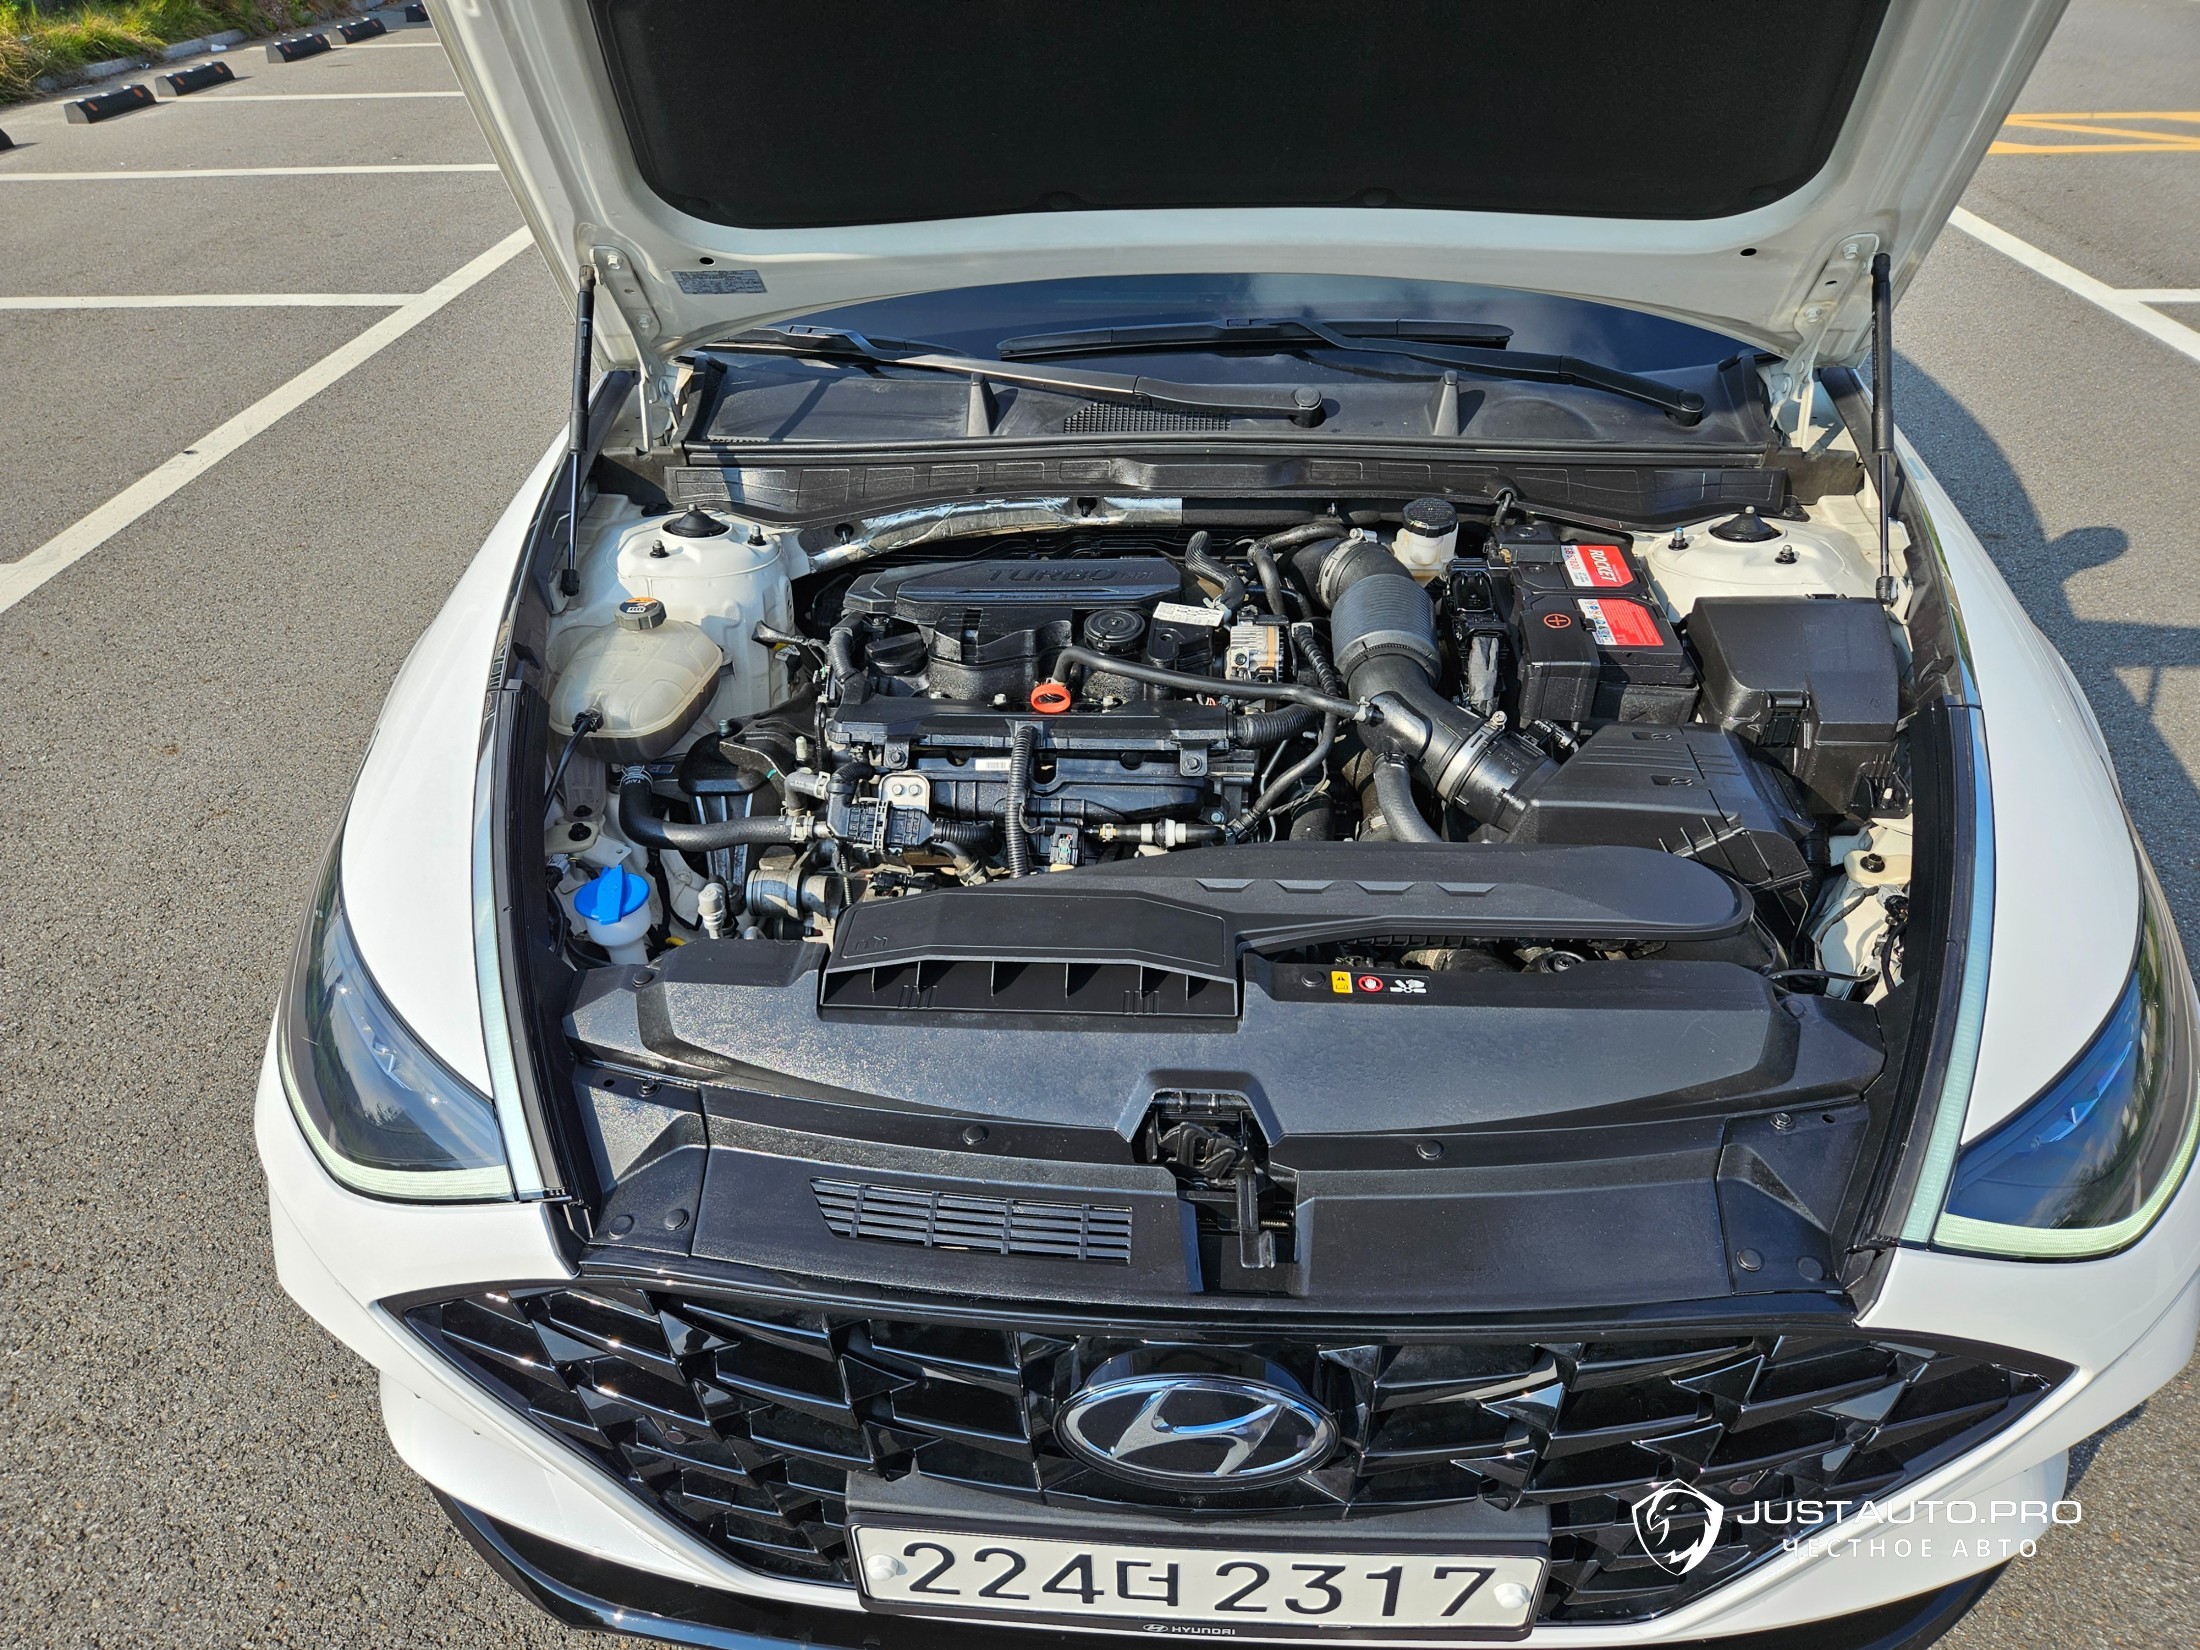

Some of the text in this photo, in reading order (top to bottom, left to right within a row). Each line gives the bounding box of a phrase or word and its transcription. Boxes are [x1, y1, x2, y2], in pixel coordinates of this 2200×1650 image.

[987, 568, 1117, 582] TURBO
[1588, 548, 1618, 583] ROCKET
[902, 1541, 1498, 1617] 224더 2317
[1171, 1625, 1236, 1636] HYUNDAI
